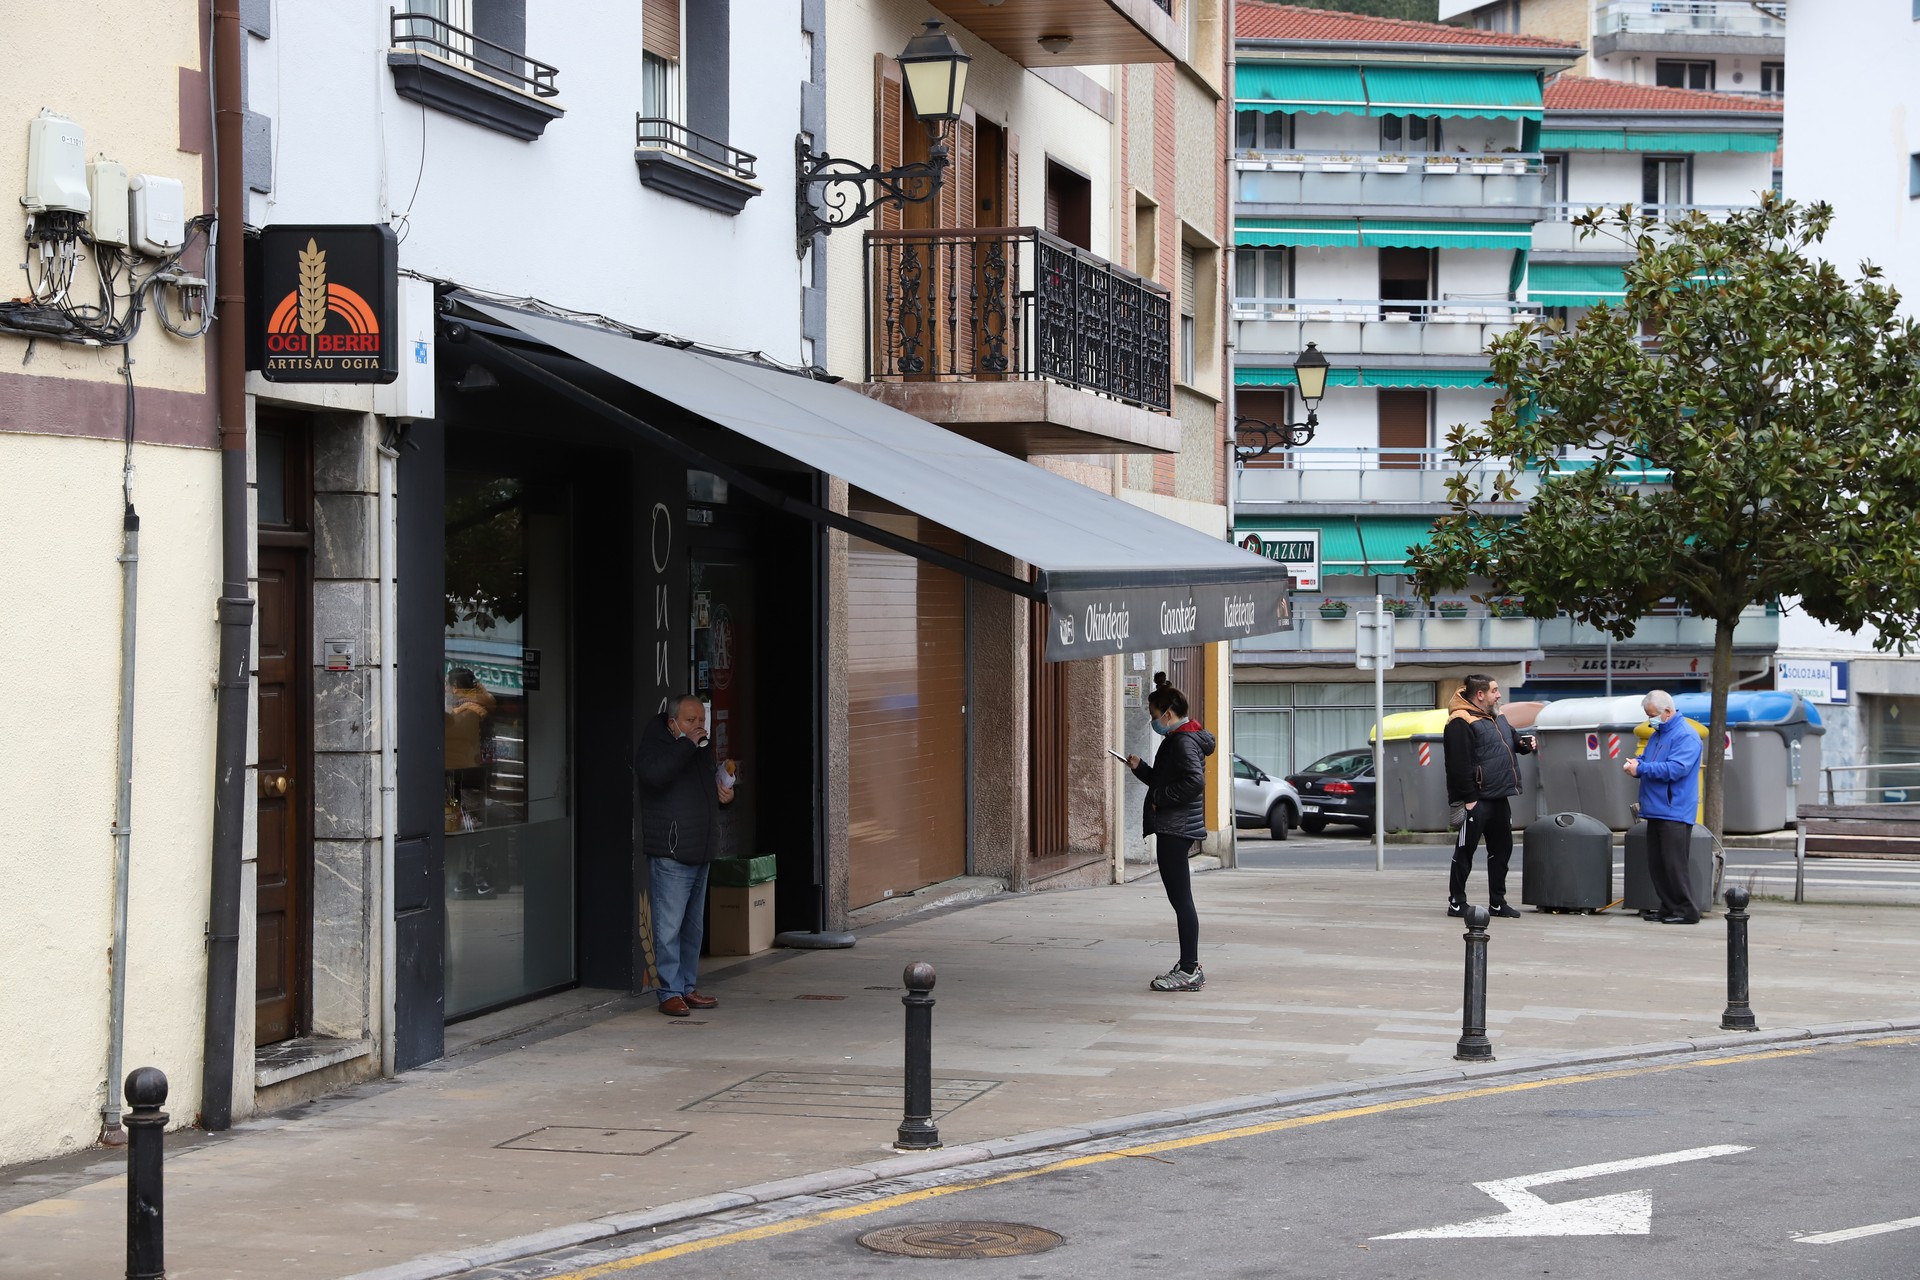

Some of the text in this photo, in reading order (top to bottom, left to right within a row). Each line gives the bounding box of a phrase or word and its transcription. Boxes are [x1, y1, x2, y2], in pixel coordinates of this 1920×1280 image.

[267, 334, 380, 351] OGI BERRI
[267, 358, 380, 369] ARTISAU OGIA
[1265, 543, 1311, 560] RAZKIN
[1224, 593, 1255, 634] Kafetegia
[1085, 601, 1129, 650] Okindegia
[1788, 667, 1830, 680] SOLOZABAL
